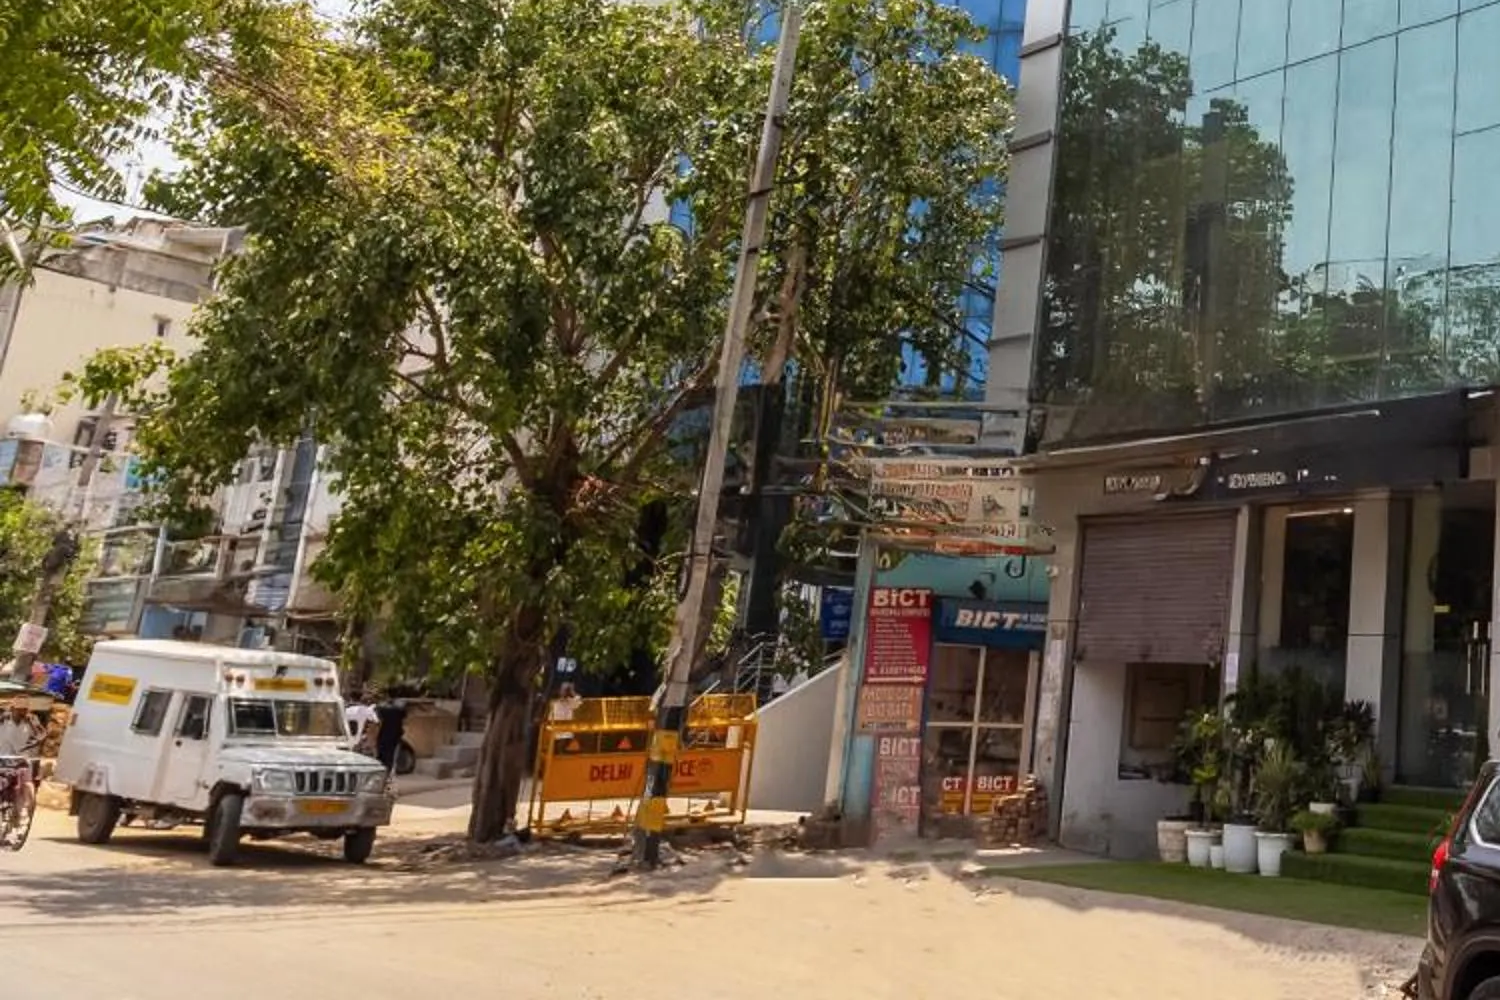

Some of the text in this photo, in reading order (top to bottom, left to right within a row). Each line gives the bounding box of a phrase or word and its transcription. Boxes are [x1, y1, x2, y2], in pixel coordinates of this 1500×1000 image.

[873, 589, 931, 607] BICT
[954, 608, 1021, 630] BICT
[879, 737, 921, 757] BICT
[589, 762, 634, 783] DELHI
[976, 775, 1013, 793] BICT
